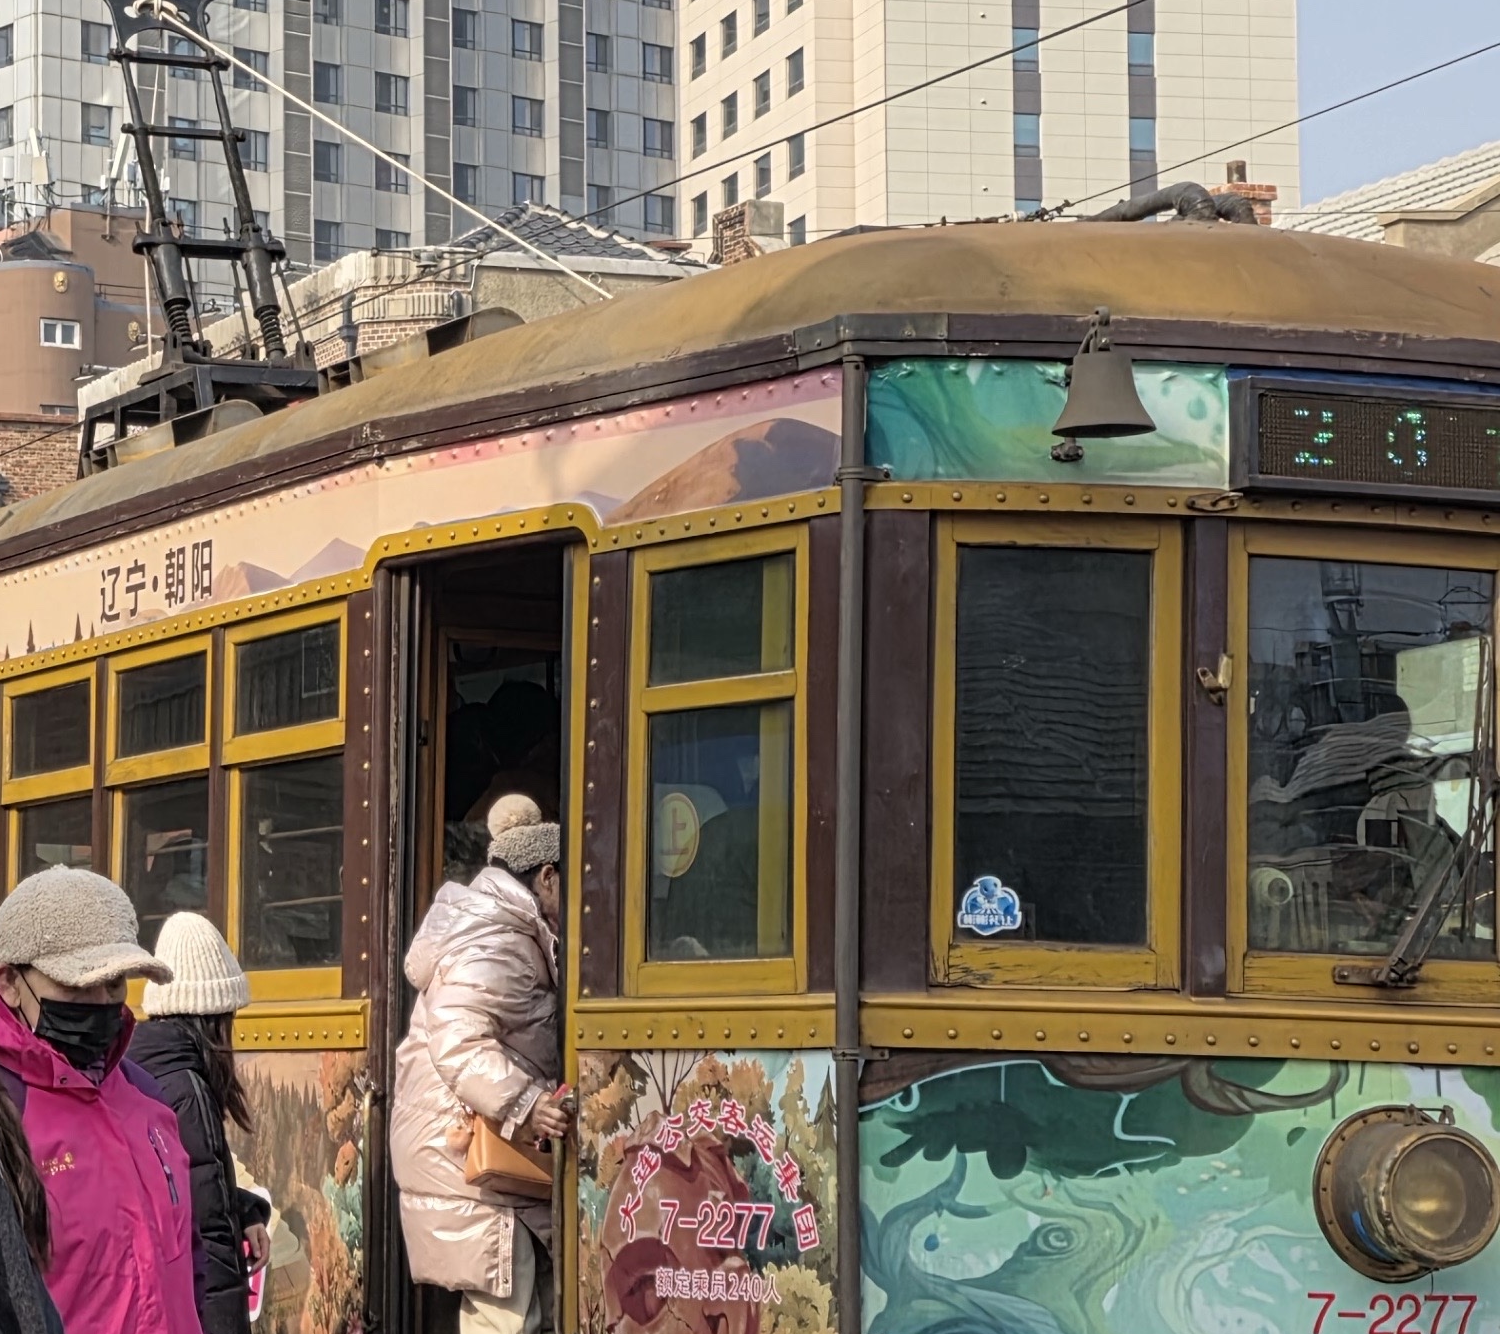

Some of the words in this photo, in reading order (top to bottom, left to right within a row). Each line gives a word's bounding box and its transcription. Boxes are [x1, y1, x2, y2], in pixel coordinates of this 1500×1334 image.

[100, 539, 212, 624] 辽宁·朝阳
[619, 1099, 820, 1251] 大连公交客运集团
[659, 1200, 775, 1250] 7-2277
[655, 1267, 782, 1305] 额定乘员240人
